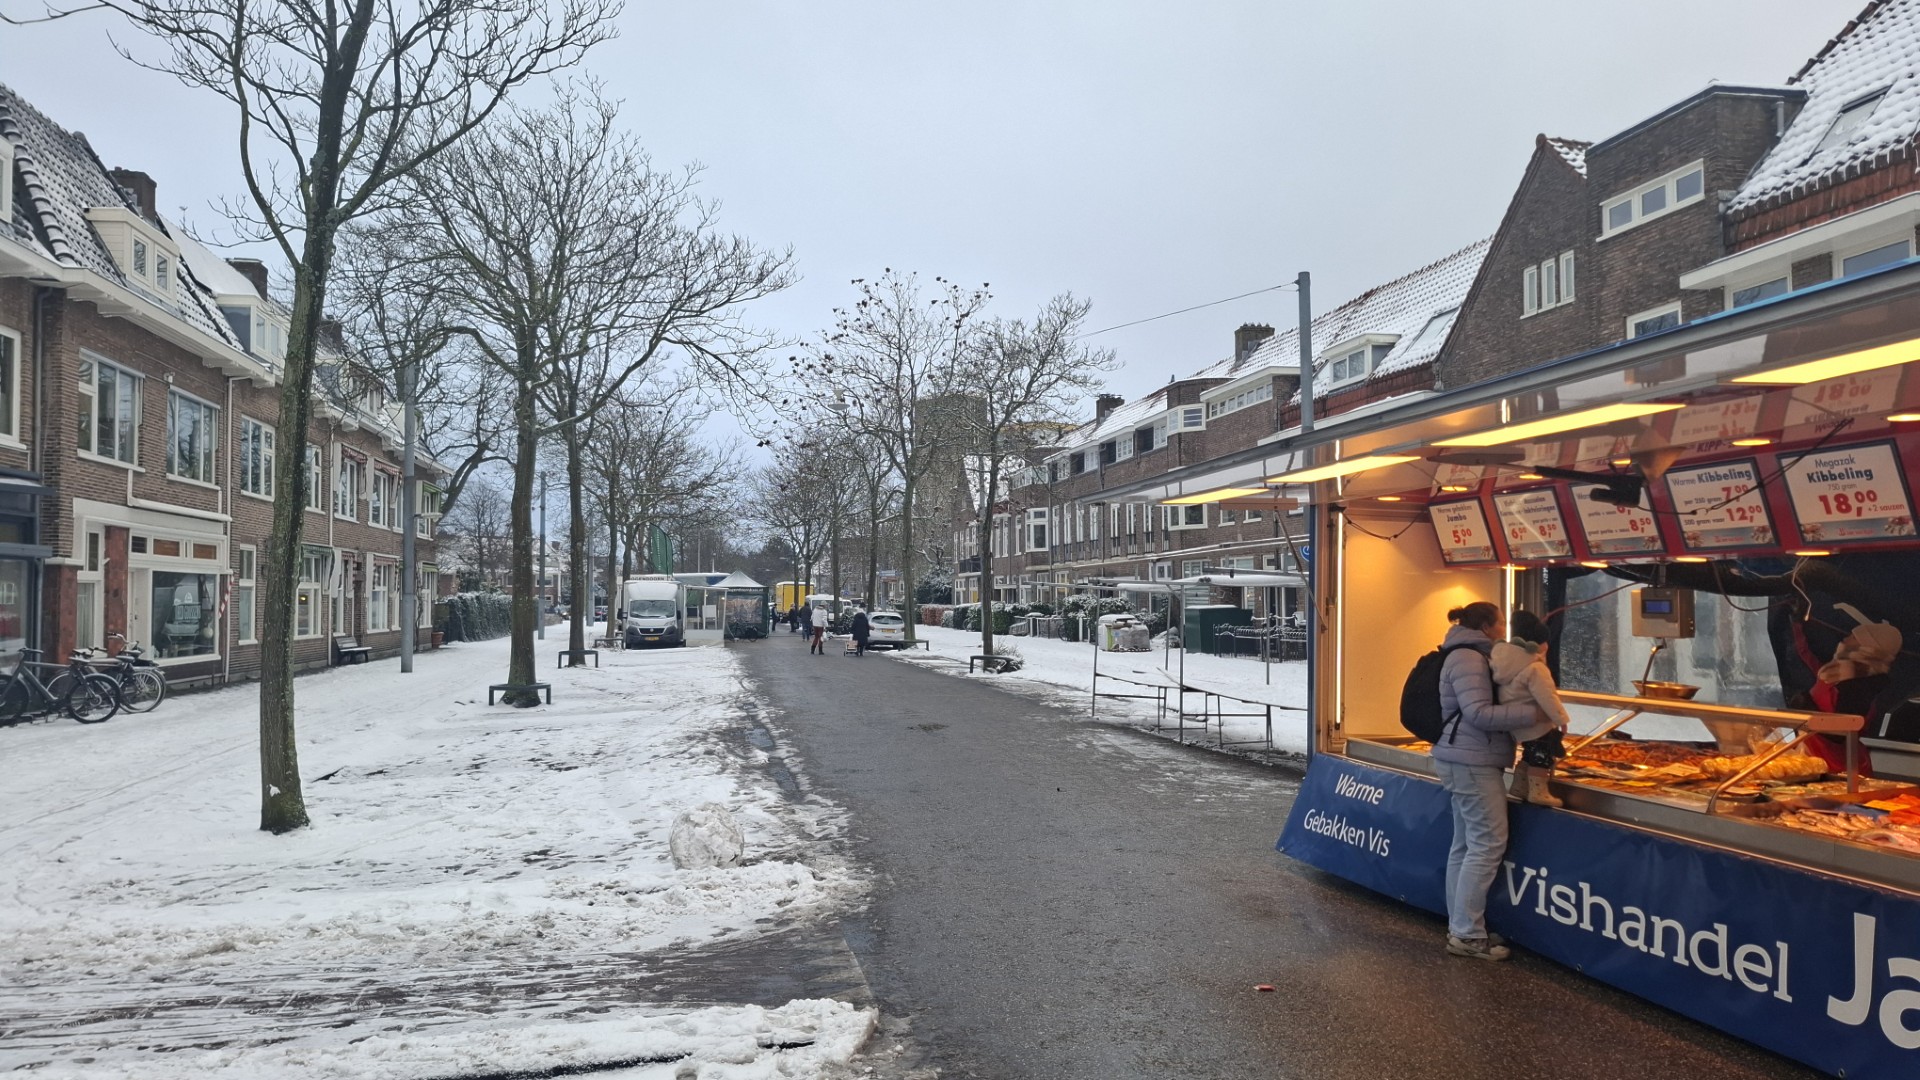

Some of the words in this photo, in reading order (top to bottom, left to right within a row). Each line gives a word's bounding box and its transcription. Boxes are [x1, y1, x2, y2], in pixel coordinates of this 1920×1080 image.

[1815, 454, 1856, 469] Megazak
[1672, 478, 1697, 487] Warme
[1697, 469, 1753, 483] Kibbeling
[1807, 468, 1874, 483] Kibbeling
[1721, 484, 1749, 503] 7,00
[1841, 483, 1857, 491] gram
[1818, 490, 1878, 517] 18,00
[1879, 503, 1905, 511] sauzen
[1447, 513, 1467, 523] Jumbo
[1726, 505, 1763, 522] 12,00
[1539, 524, 1557, 538] 8,50
[1629, 517, 1652, 533] 8,50
[1452, 528, 1472, 546] 5,00
[1334, 772, 1385, 806] Warme
[1303, 807, 1366, 846] Gebakken
[1367, 826, 1391, 857] Vis
[1502, 859, 1792, 1003] Vishandel
